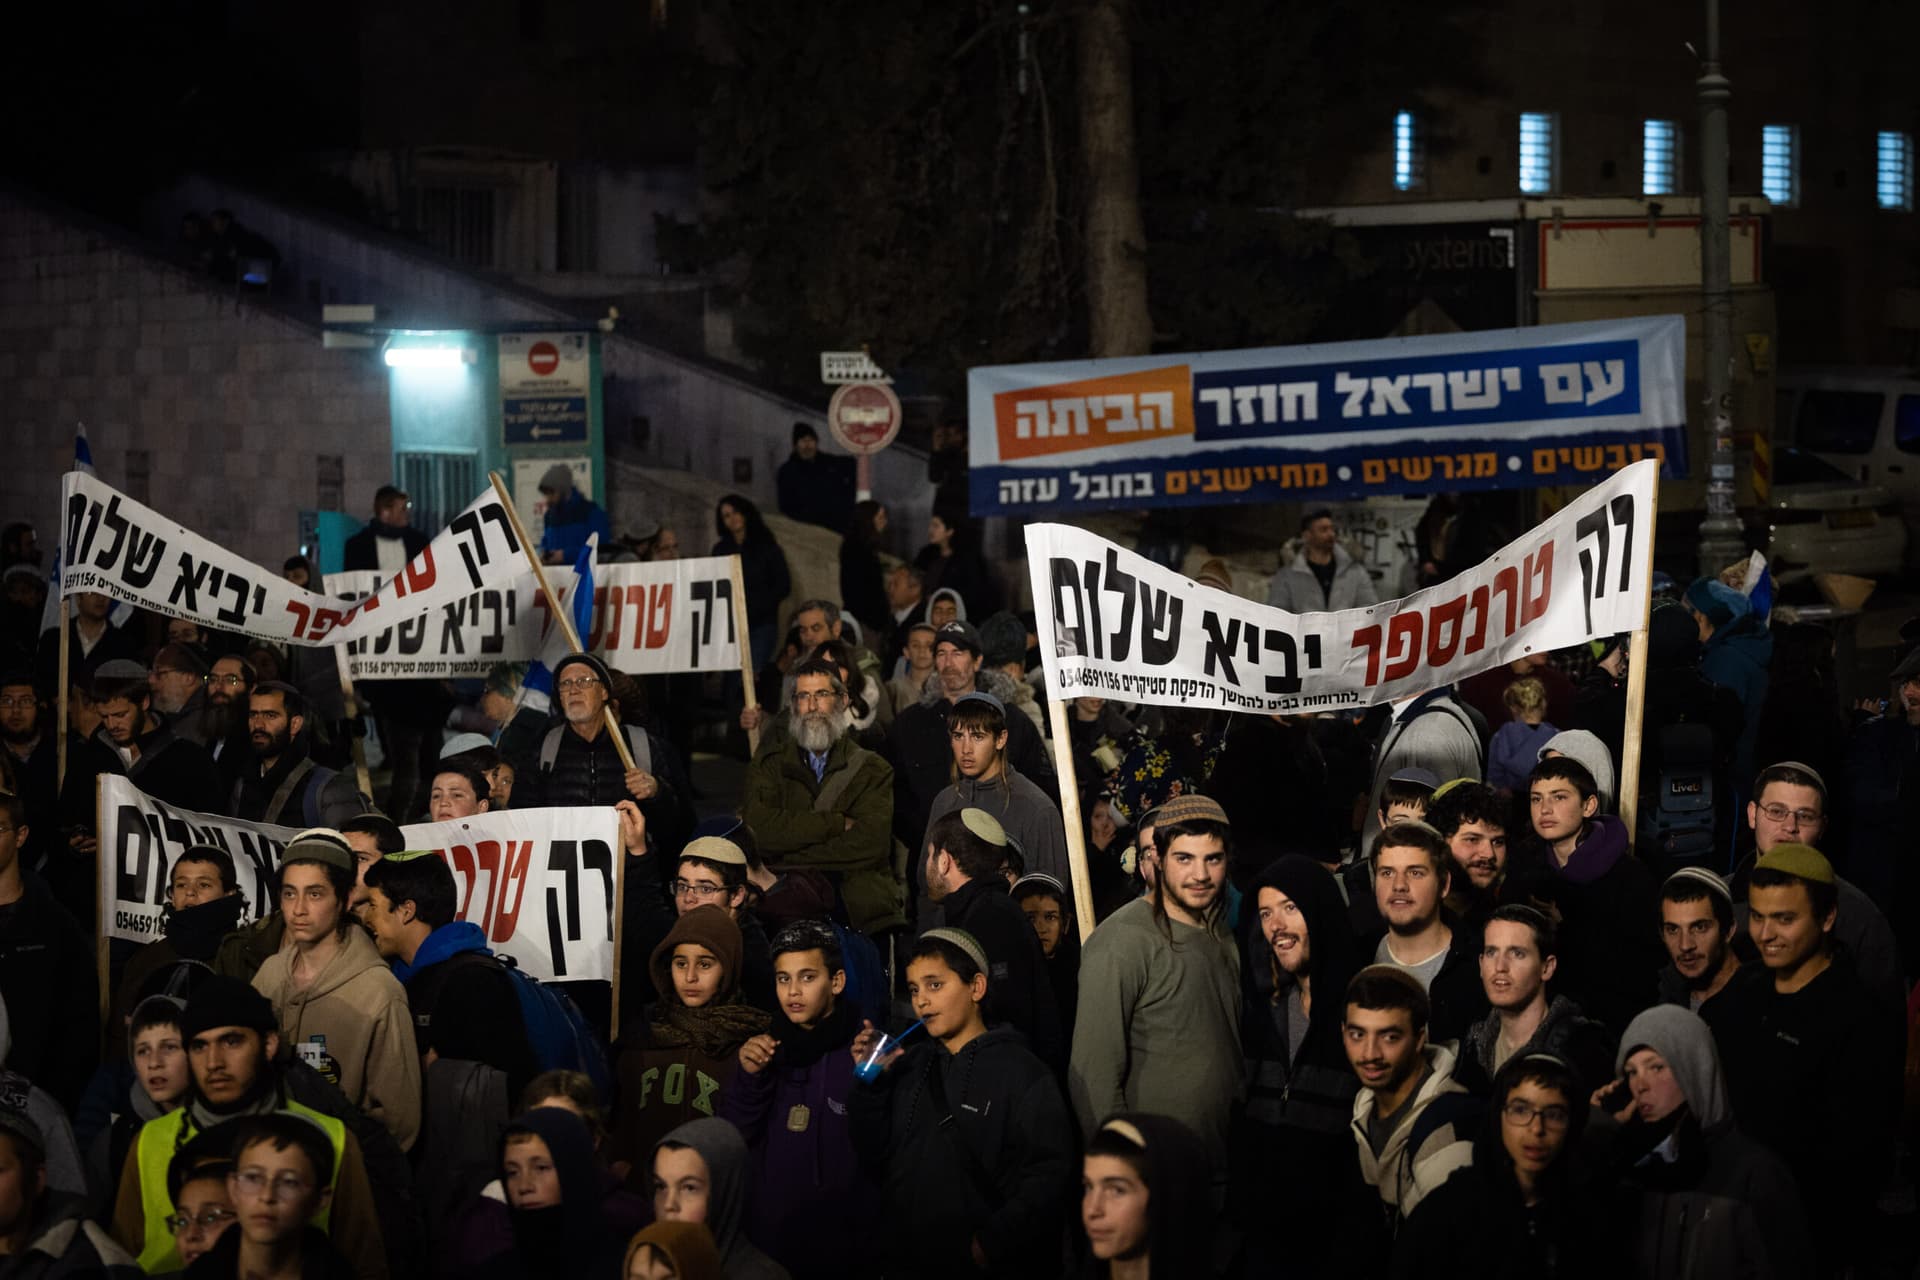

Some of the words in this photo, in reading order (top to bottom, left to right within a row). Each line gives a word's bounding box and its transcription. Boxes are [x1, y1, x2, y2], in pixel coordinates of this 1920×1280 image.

[1199, 378, 1319, 428] חוזר
[1334, 365, 1522, 420] ישראל
[1538, 358, 1626, 407] עם
[1014, 390, 1175, 440] הביתה
[998, 475, 1060, 506] עזה
[1072, 464, 1154, 500] בחבל
[1165, 461, 1328, 496] מתיישבים
[1362, 452, 1498, 485] מגרשים
[66, 493, 168, 589] שלום
[450, 502, 521, 589] רק
[1575, 493, 1635, 635] רק
[97, 576, 138, 603] סטיקרים
[167, 551, 268, 627] יביא
[1049, 546, 1184, 666] שלום
[1350, 539, 1554, 688] טרנספר
[440, 588, 517, 656] יביא
[690, 577, 736, 669] רק
[380, 660, 416, 677] סטיקרים
[417, 660, 447, 674] הדפסת
[1202, 606, 1322, 695] יביא
[1059, 668, 1121, 691] 0546591156
[1122, 673, 1167, 699] סטיקרים
[1170, 677, 1216, 701] הדפסת
[1219, 686, 1264, 710] להמשך
[1267, 697, 1300, 711] בביט
[1672, 783, 1701, 793] LiveU
[431, 838, 534, 944] טרנ
[545, 838, 615, 977] רק
[638, 1063, 721, 1117] FOX
